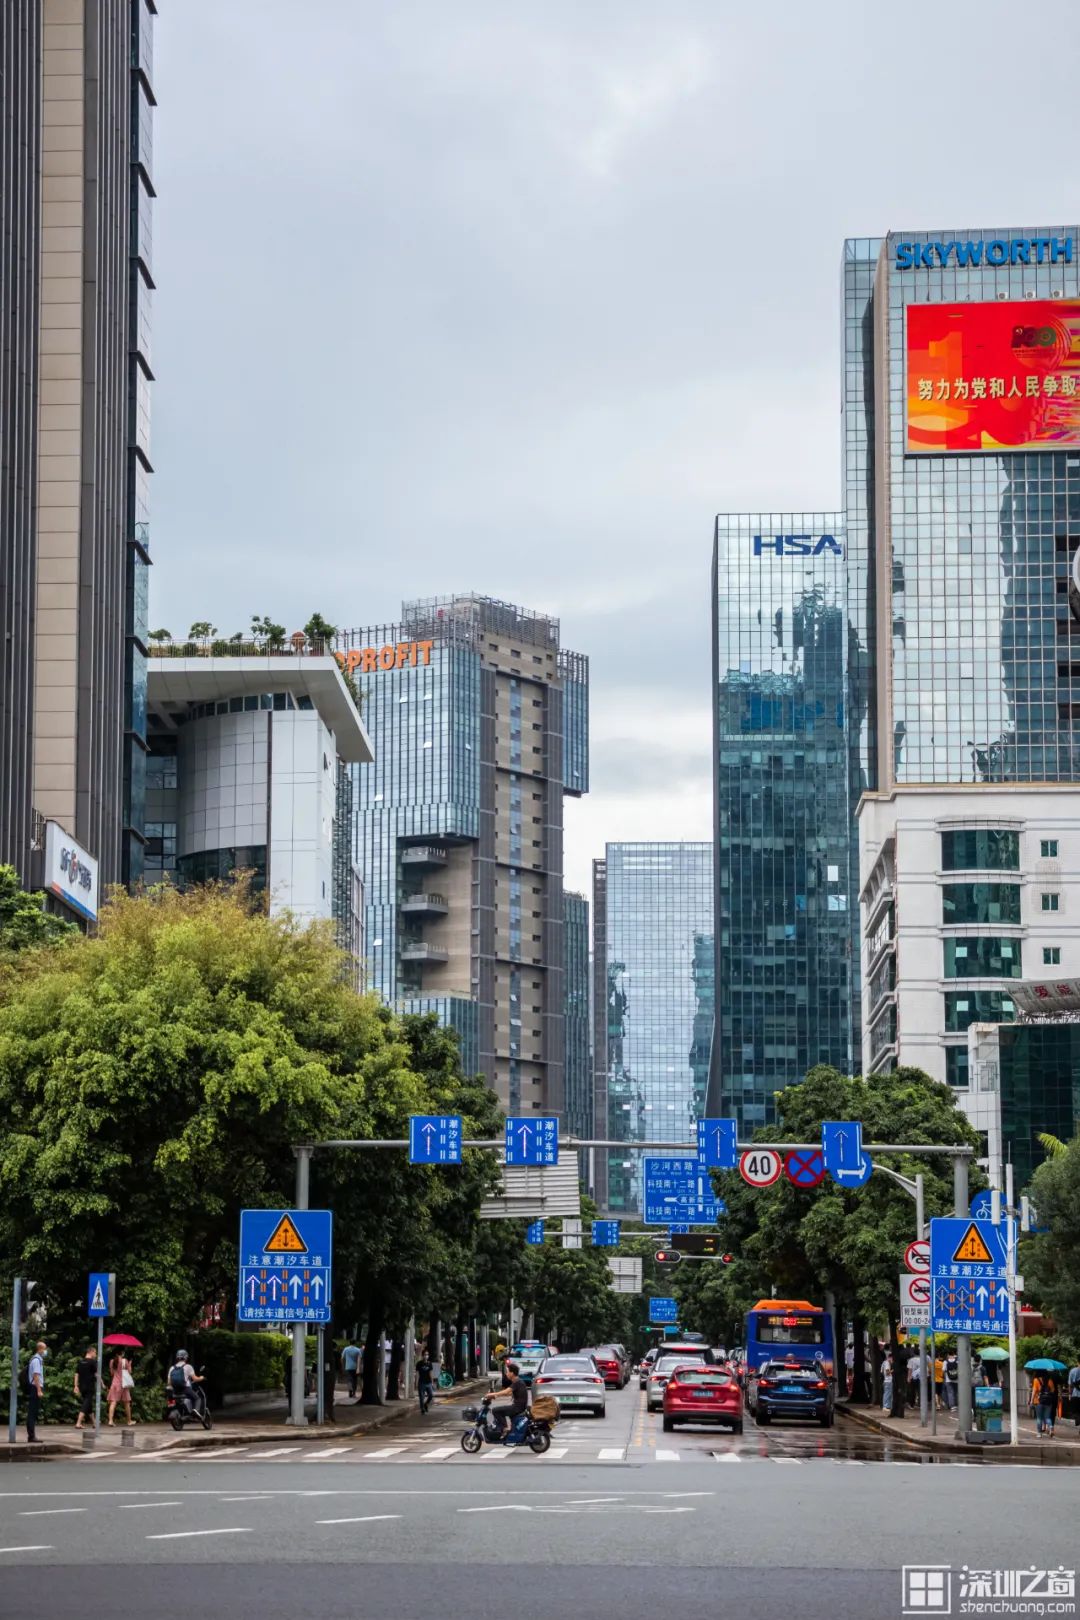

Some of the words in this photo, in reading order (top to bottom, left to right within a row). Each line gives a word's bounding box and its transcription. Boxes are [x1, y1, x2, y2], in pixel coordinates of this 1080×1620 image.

[895, 237, 1073, 270] SKYWORTH
[917, 375, 1077, 401] 努力为党和人民争取
[754, 535, 842, 555] HSA
[448, 1119, 458, 1161] 潮汐车道
[544, 1120, 554, 1162] 潮汐车道
[651, 1161, 693, 1171] 沙河西路
[748, 1156, 771, 1176] 40
[647, 1179, 695, 1189] 科技南十二路
[647, 1206, 695, 1216] 科技南十一路
[248, 1254, 322, 1266] 注意潮汐车道
[937, 1264, 1007, 1276] 注意潮汐车道
[243, 1307, 325, 1319] 请按车道信号通行
[935, 1318, 1010, 1332] 请按车道信号通行
